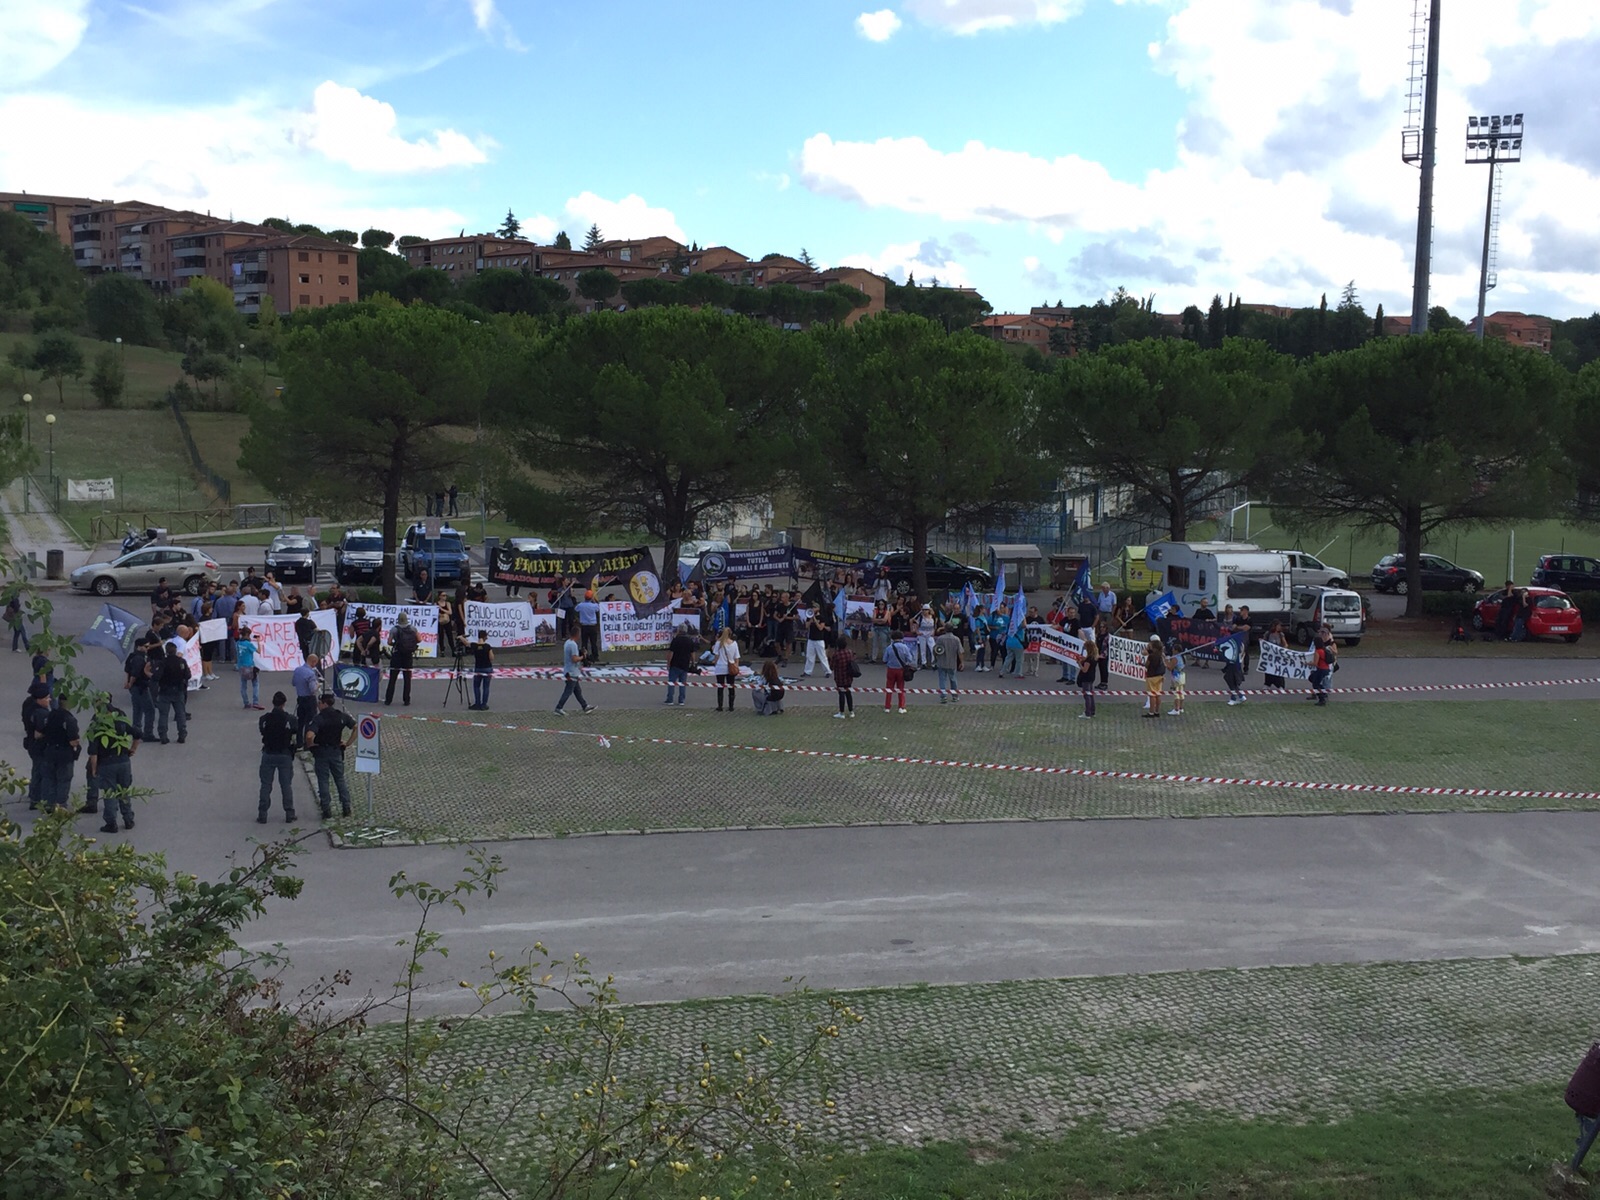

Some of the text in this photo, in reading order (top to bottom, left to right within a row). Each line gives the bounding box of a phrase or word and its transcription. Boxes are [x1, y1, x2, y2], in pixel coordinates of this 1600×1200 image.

[729, 548, 786, 559] MOVIMENTO ETICO
[726, 565, 754, 573] ANIMALI
[759, 562, 790, 571] AMBIENTE
[607, 602, 632, 612] PER
[1110, 637, 1148, 653] ABOLIZION
[1261, 641, 1307, 661] QUESTA
[1109, 647, 1123, 662] DEL
[1261, 652, 1296, 668] CORSA
